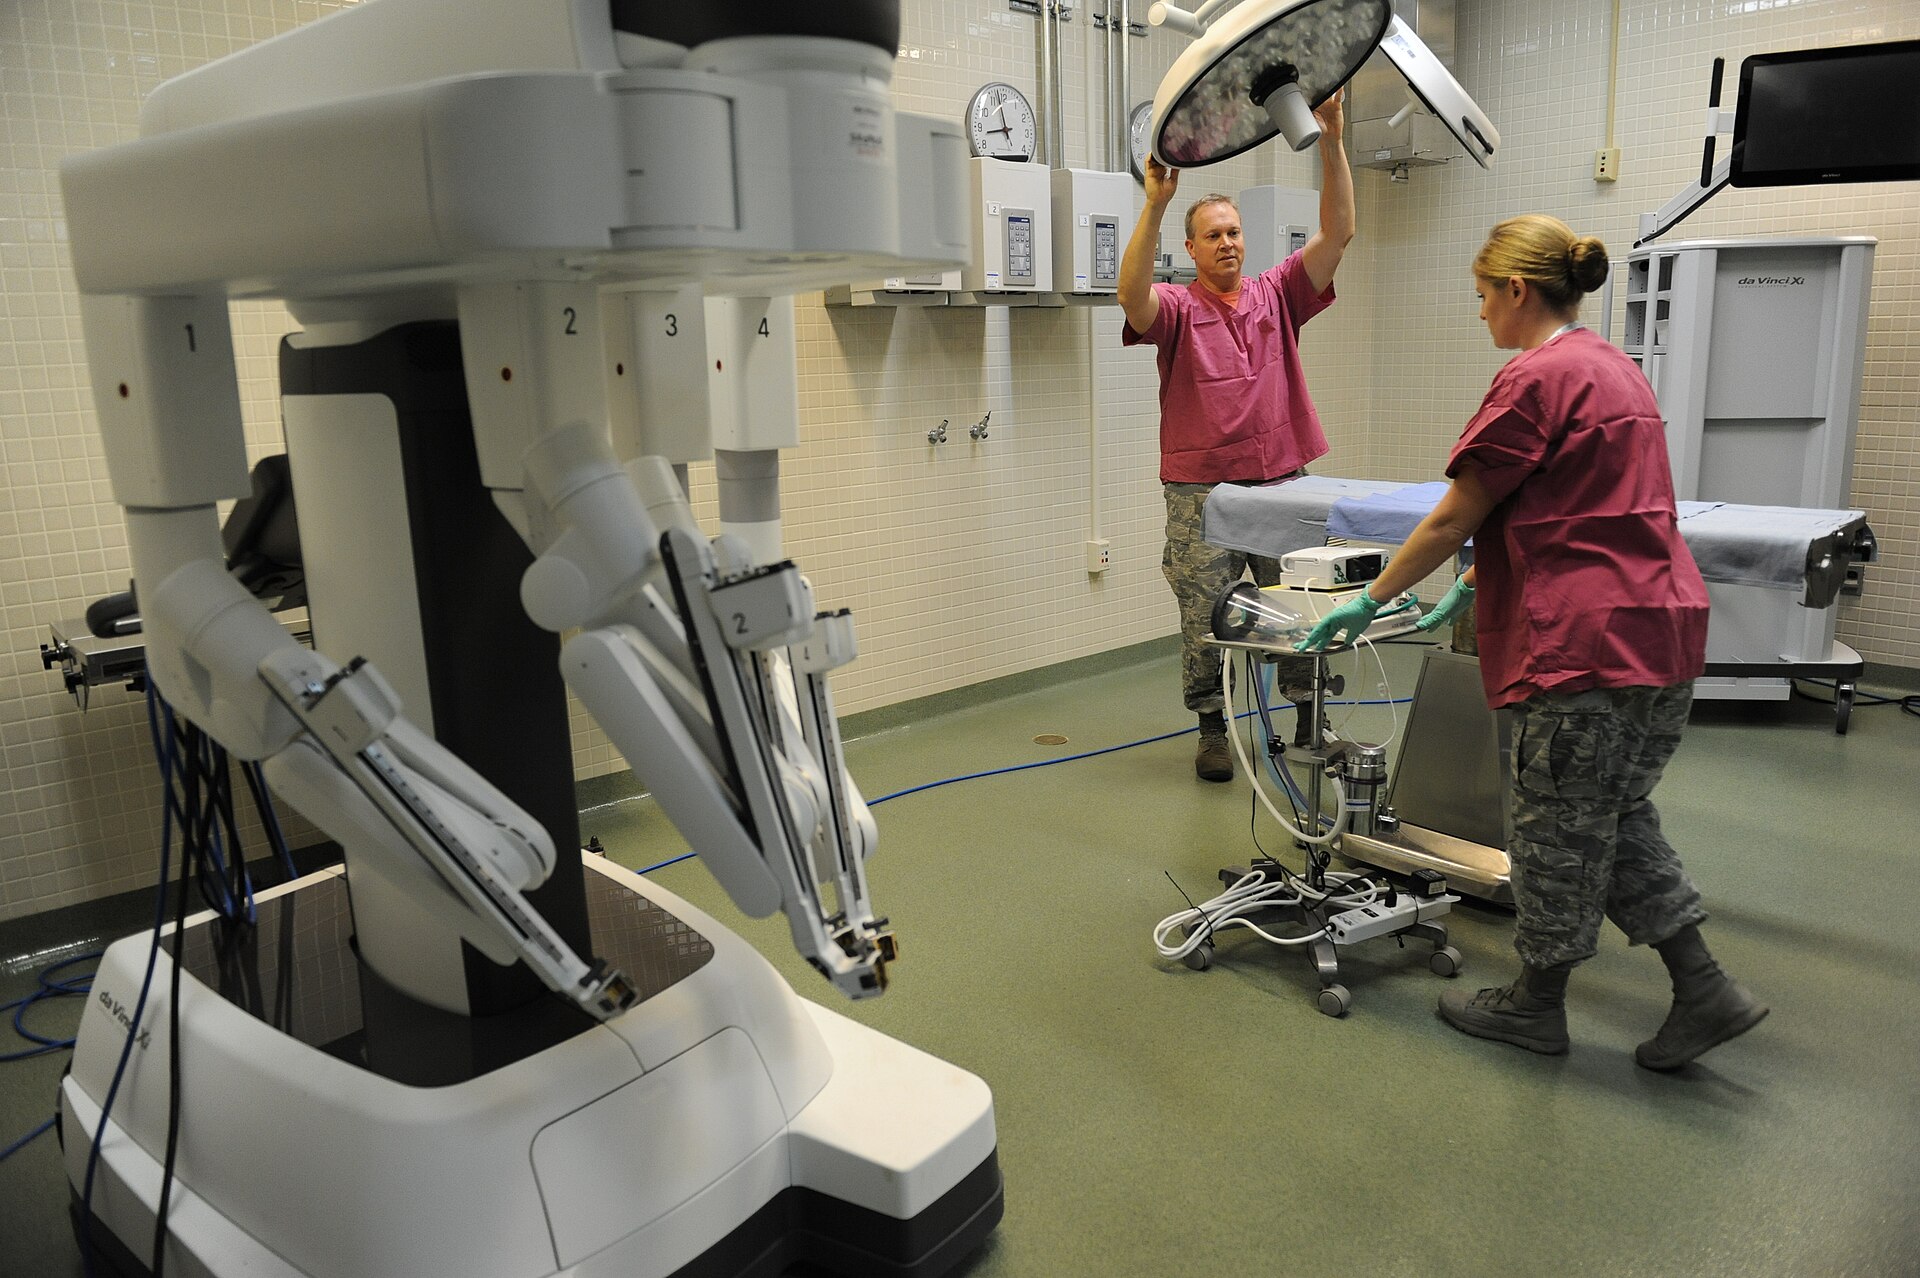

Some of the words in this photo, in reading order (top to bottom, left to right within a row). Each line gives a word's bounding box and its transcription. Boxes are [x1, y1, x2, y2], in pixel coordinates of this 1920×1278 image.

[1000, 94, 1007, 103] 12
[1021, 113, 1027, 123] 2
[977, 122, 983, 133] 9
[1024, 129, 1030, 139] 3
[981, 139, 987, 150] 8
[1021, 144, 1027, 154] 4
[1738, 277, 1755, 285] da
[1758, 276, 1790, 285] Vinci
[1790, 276, 1805, 286] Xi
[563, 306, 577, 335] 2
[664, 313, 678, 337] 3
[757, 317, 770, 338] 4
[184, 323, 196, 353] 1
[732, 612, 749, 635] 2
[99, 991, 113, 1010] da
